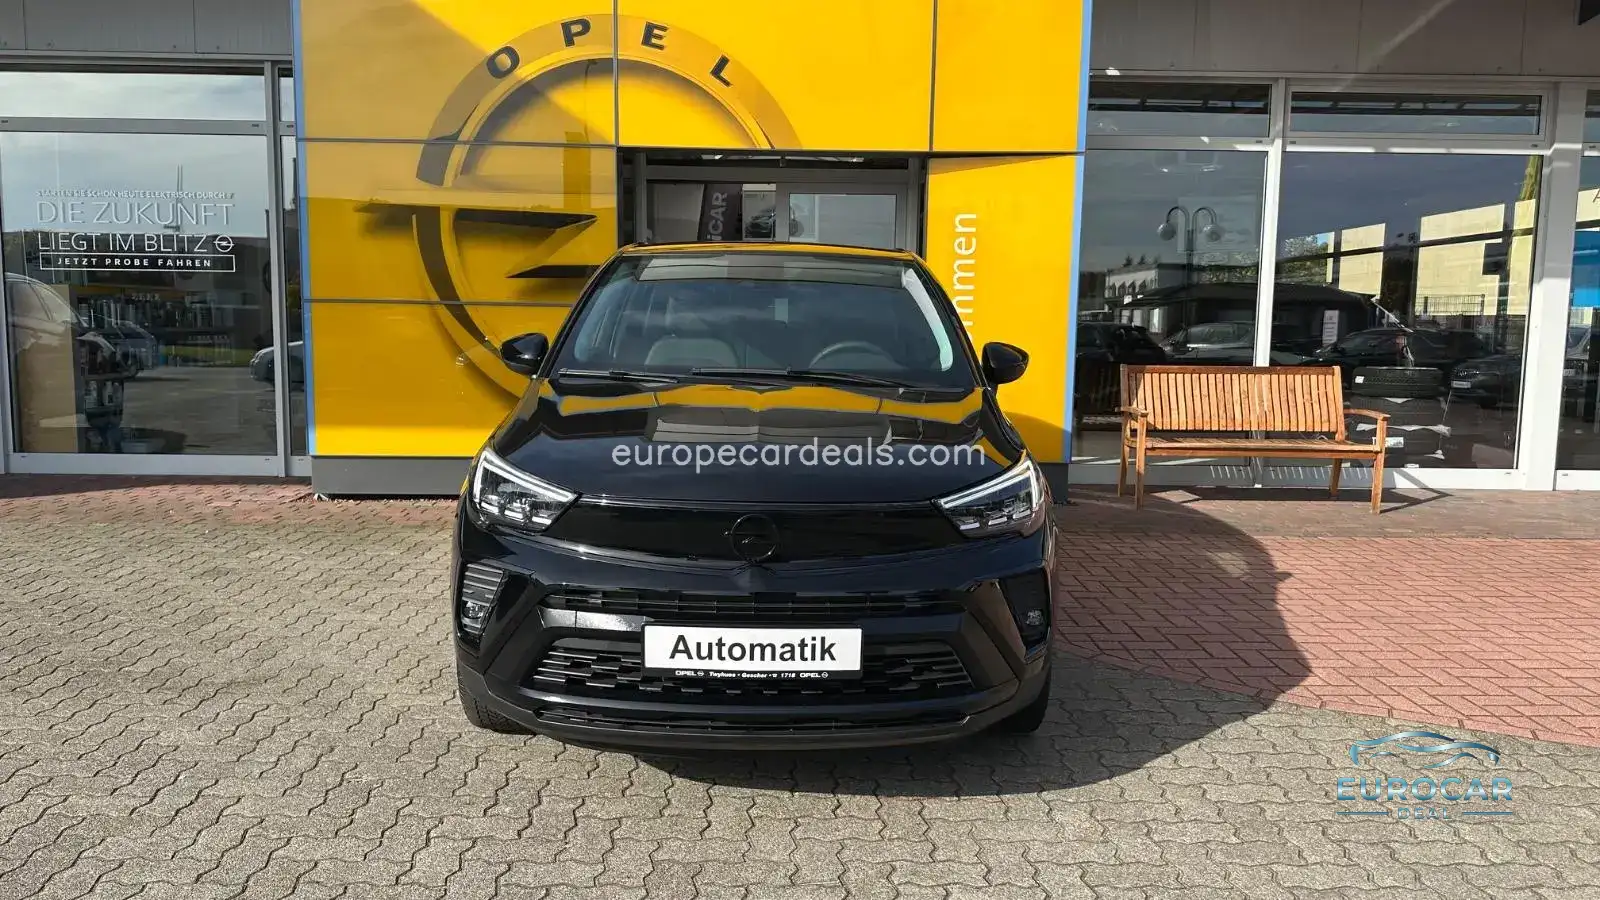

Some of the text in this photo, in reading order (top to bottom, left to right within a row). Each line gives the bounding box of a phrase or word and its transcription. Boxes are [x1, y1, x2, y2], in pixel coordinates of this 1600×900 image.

[485, 16, 734, 88] OPEL
[37, 201, 235, 225] DIE ZUKUNFT
[38, 231, 208, 252] LIEGT IM BLITZ
[57, 257, 212, 268] JETZT PROBE FAHREN
[669, 634, 836, 662] Automatik
